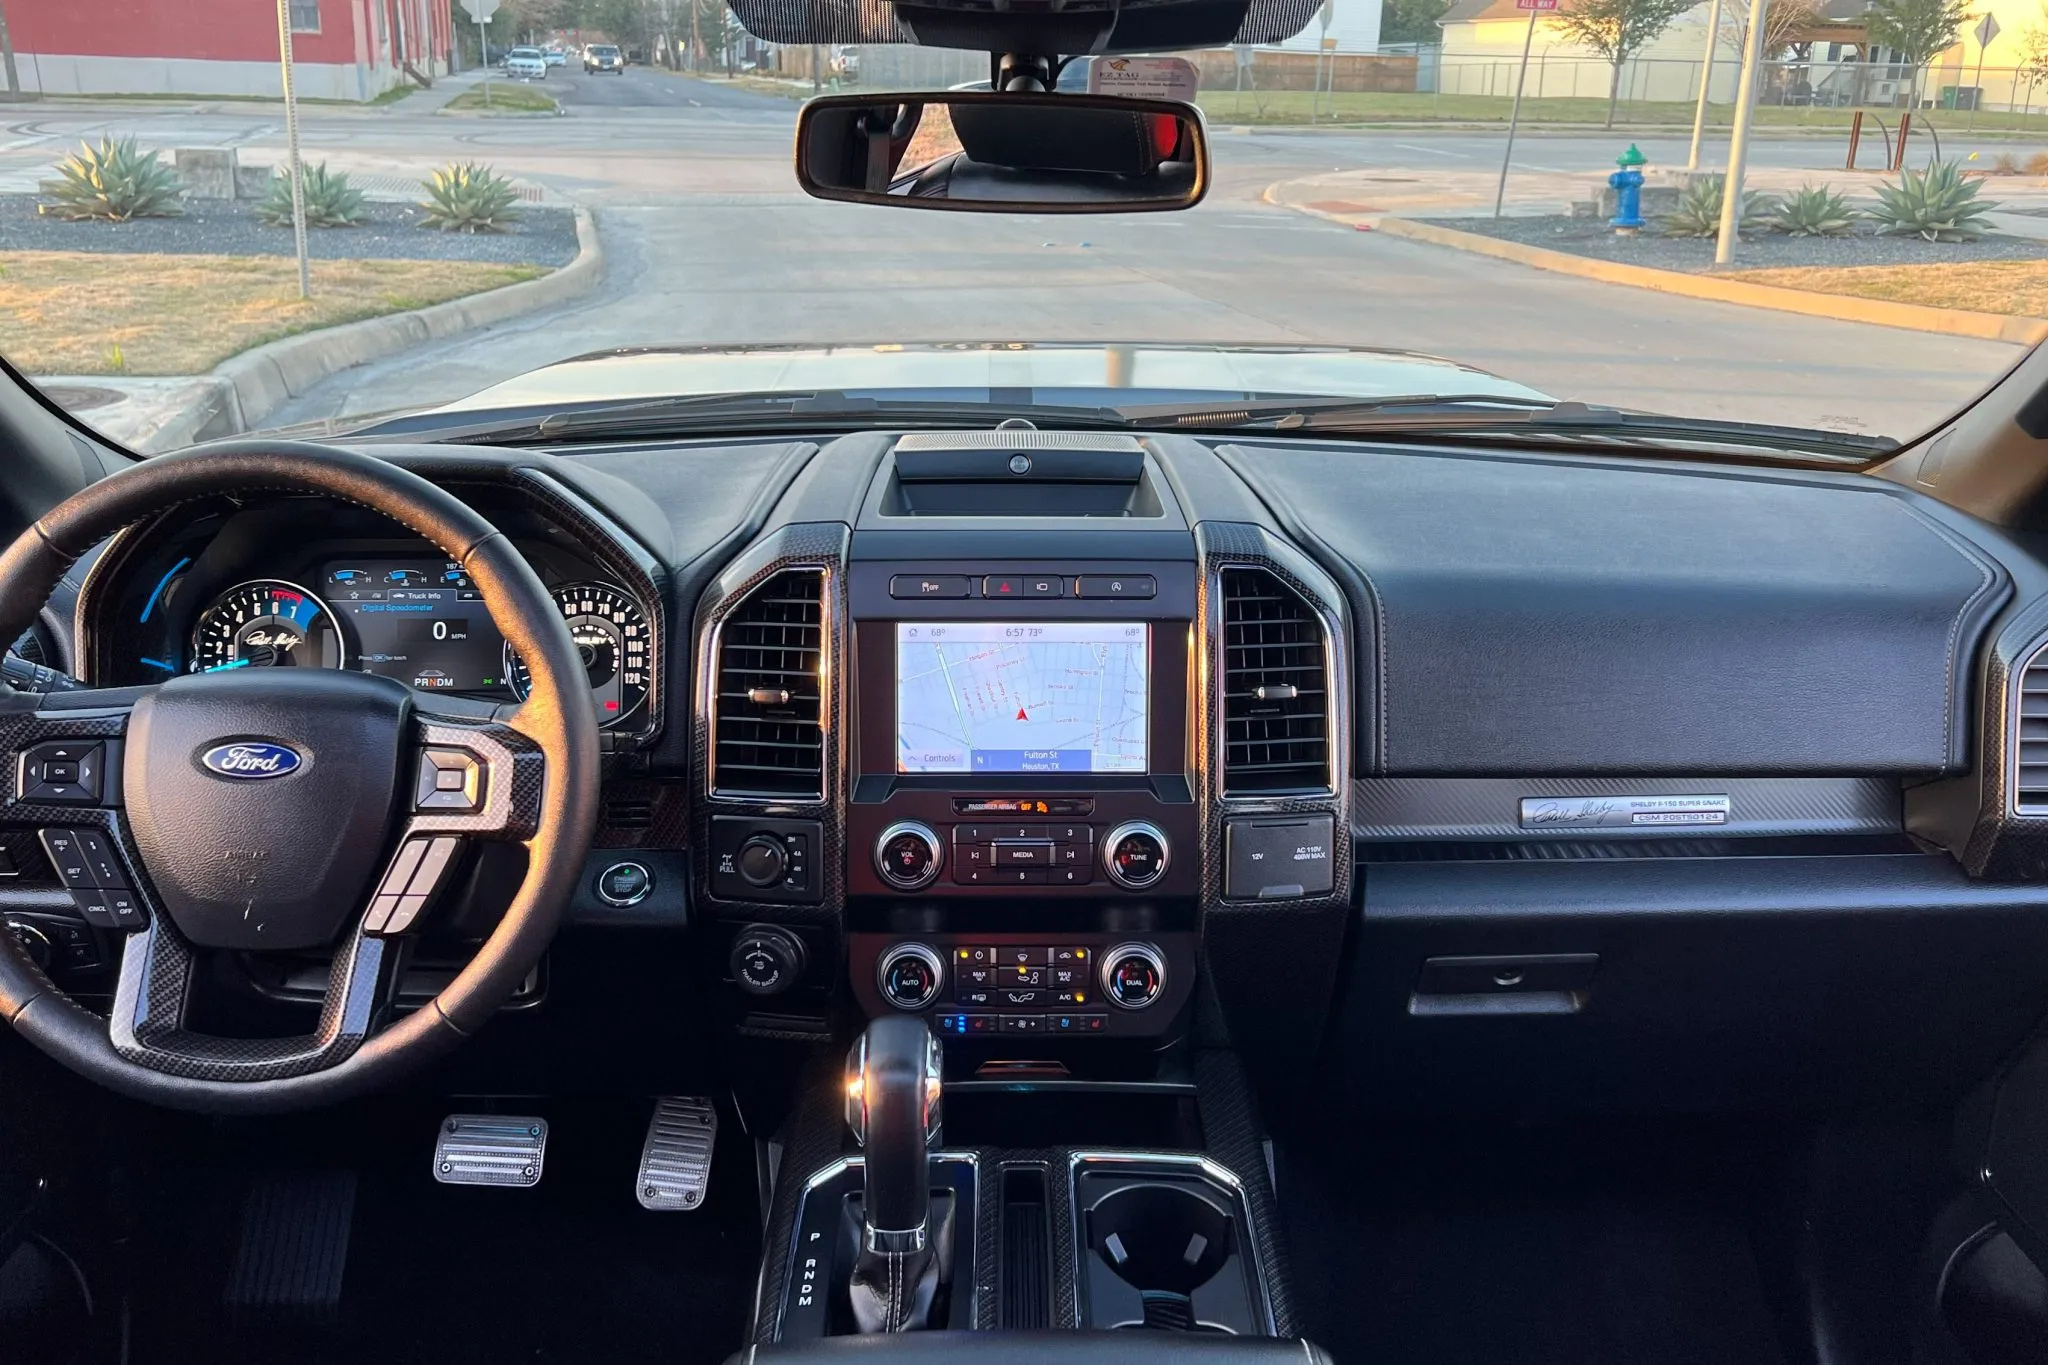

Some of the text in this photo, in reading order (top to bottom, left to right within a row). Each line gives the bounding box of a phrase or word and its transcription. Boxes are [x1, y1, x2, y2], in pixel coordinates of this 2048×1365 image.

[1537, 0, 1554, 8] WAY
[408, 592, 442, 600] Truck Info
[254, 602, 261, 616] 5
[272, 602, 279, 614] 6
[362, 604, 434, 612] Digital Speedometer
[564, 603, 577, 615] 50
[581, 600, 593, 612] 60
[598, 603, 610, 615] 70
[236, 610, 244, 624] 4
[290, 606, 297, 619] 7
[613, 612, 626, 623] 80
[222, 625, 230, 638] 3
[432, 621, 447, 640] 0
[625, 625, 637, 636] 90
[1006, 628, 1024, 637] 6:57
[216, 641, 223, 654] 2
[627, 641, 644, 652] 100
[627, 656, 642, 668] 110
[624, 672, 640, 684] 120
[221, 746, 282, 771] Ford
[924, 754, 956, 762] Controls
[977, 756, 984, 764] N
[1024, 751, 1058, 759] Fulton St
[742, 968, 778, 986] TRAILER BACKUP
[810, 1232, 820, 1242] P
[806, 1259, 816, 1268] R
[804, 1270, 815, 1280] N
[801, 1284, 812, 1294] D
[798, 1296, 812, 1306] M
